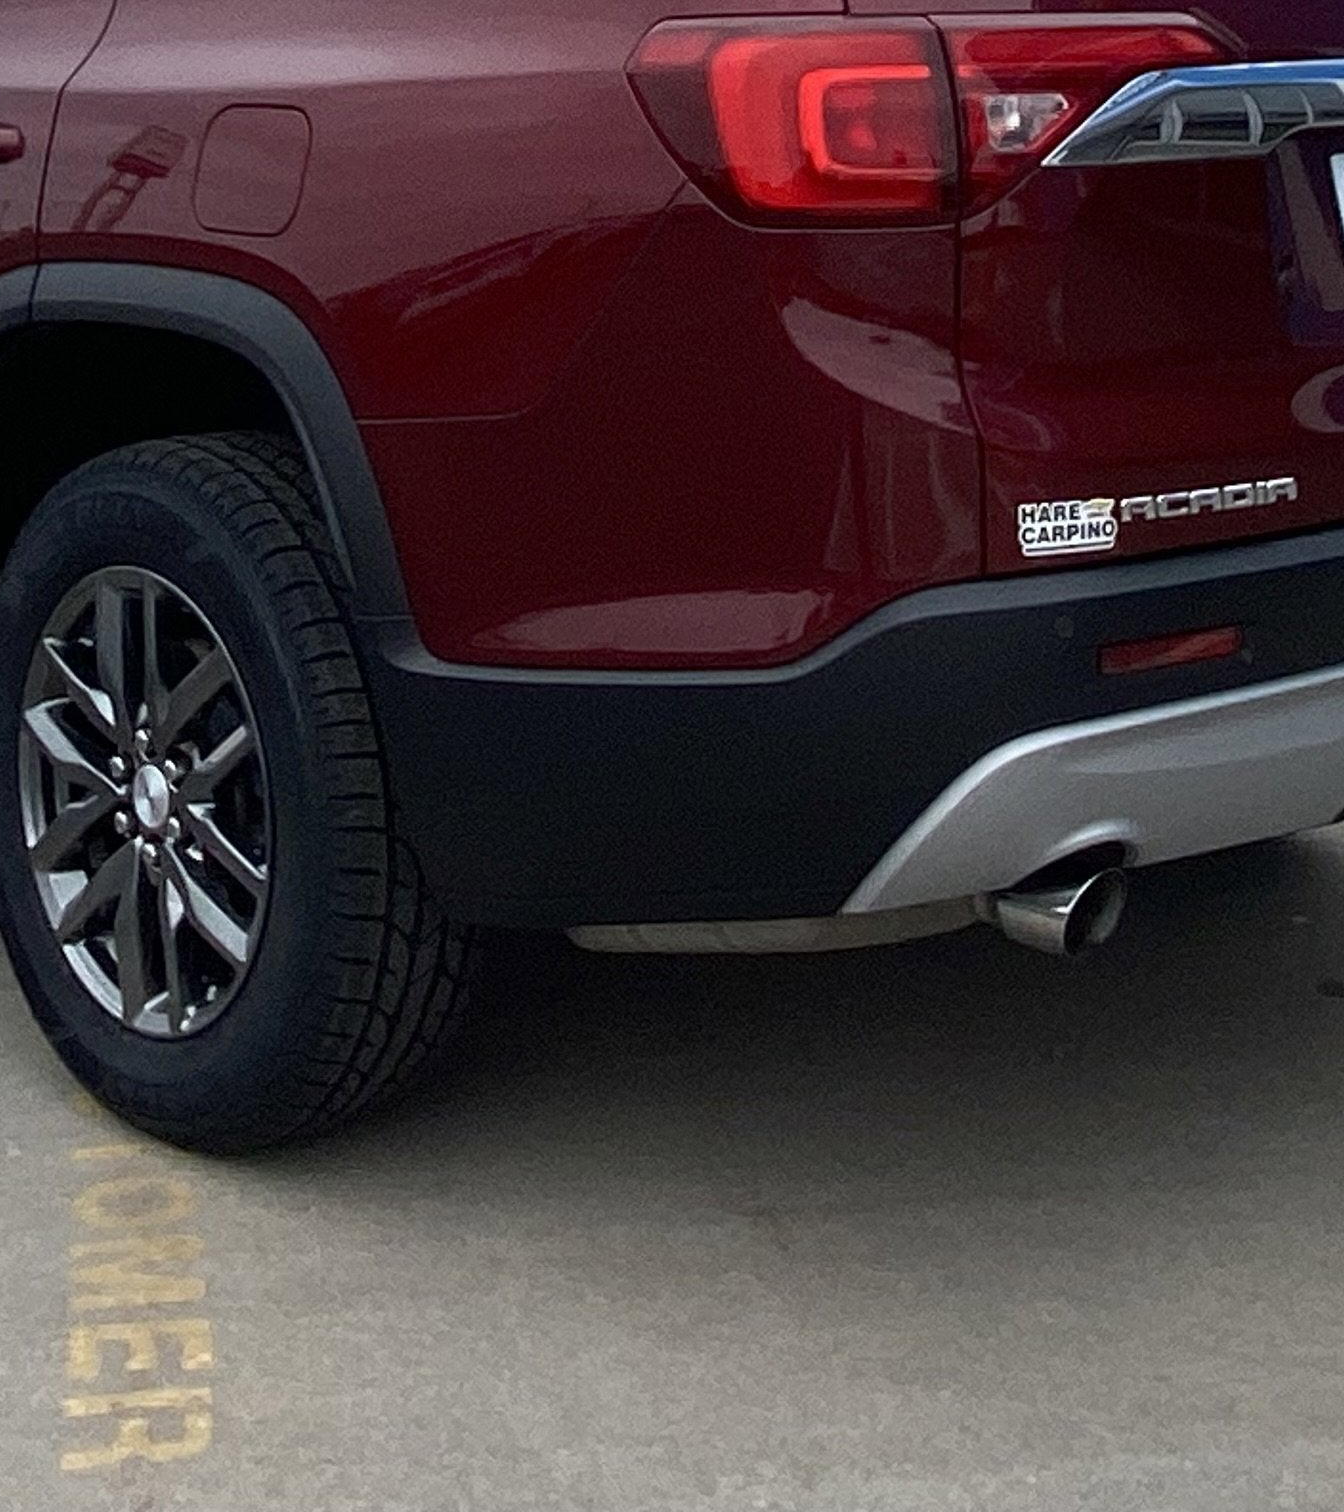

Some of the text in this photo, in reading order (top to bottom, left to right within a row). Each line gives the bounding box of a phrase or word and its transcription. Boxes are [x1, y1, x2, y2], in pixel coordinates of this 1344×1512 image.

[1120, 476, 1298, 522] ACADIA
[1020, 503, 1080, 524] HARE
[1020, 520, 1114, 544] CARPINO
